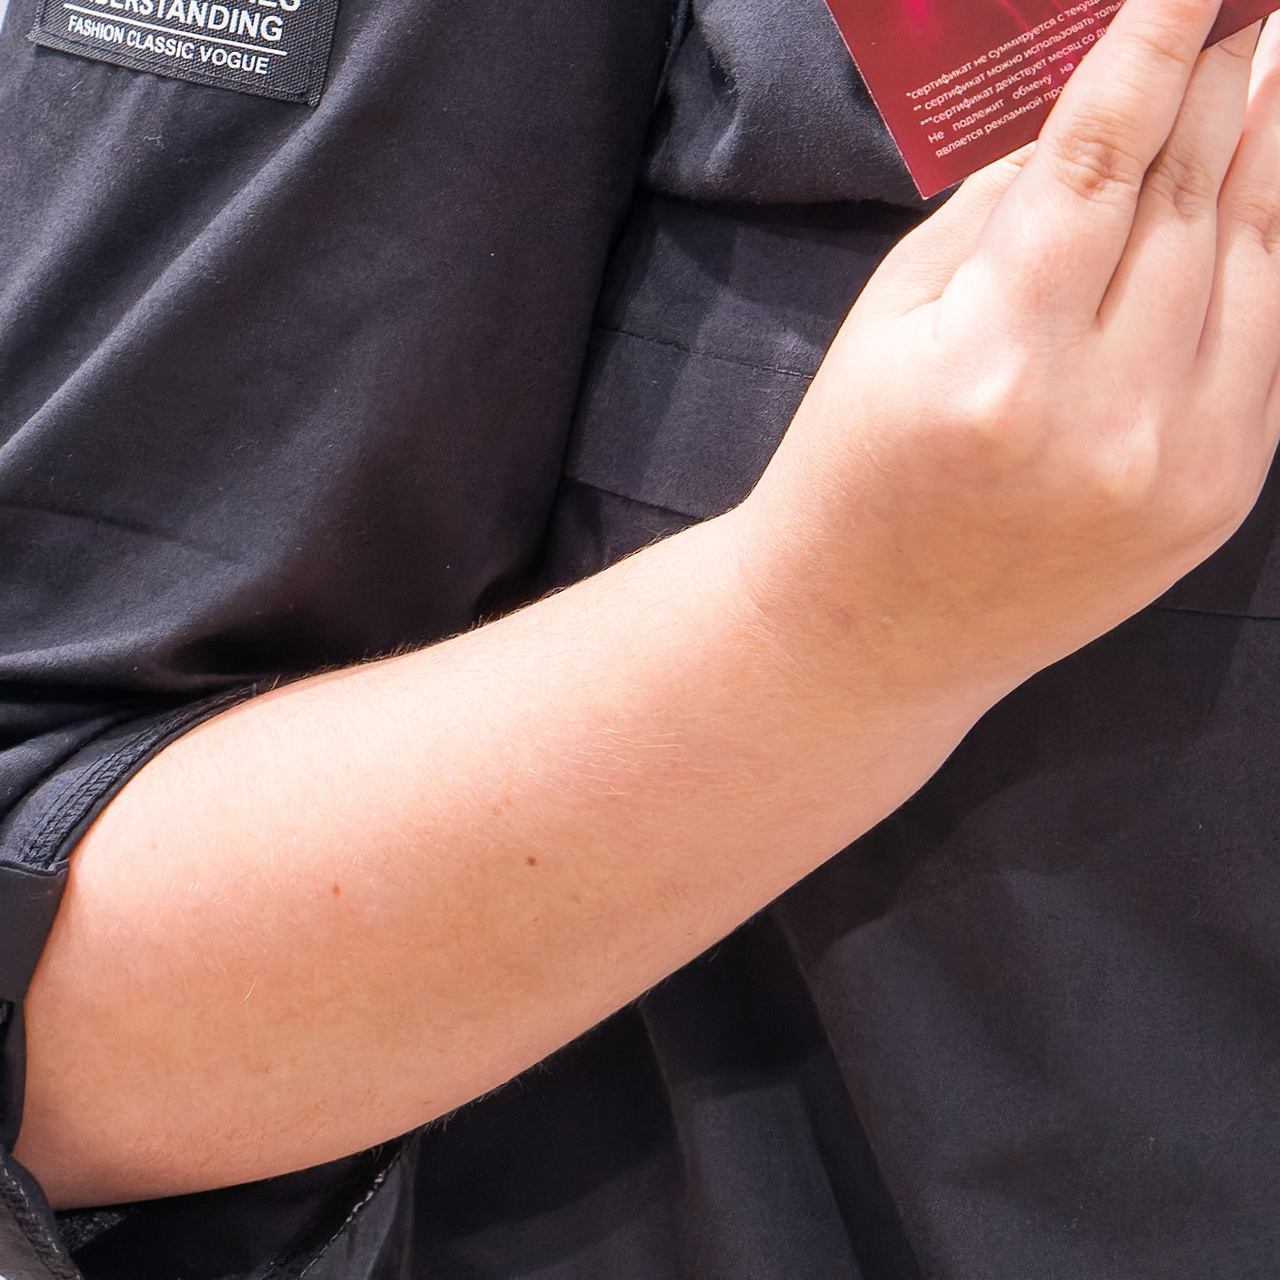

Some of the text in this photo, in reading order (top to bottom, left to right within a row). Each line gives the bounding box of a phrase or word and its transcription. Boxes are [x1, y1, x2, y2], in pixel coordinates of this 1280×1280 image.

[67, 15, 271, 75] FASHION CLASSIC VOGUE
[924, 72, 985, 111] сертификат
[986, 53, 1023, 77] можно
[1022, 17, 1095, 59] использовать
[994, 57, 1048, 92] действует
[1047, 41, 1083, 63] месяц
[928, 130, 945, 144] Не
[952, 98, 1005, 132] подлежит
[1012, 74, 1053, 101] обмену
[935, 128, 984, 158] является
[983, 96, 1044, 135] рекламной
